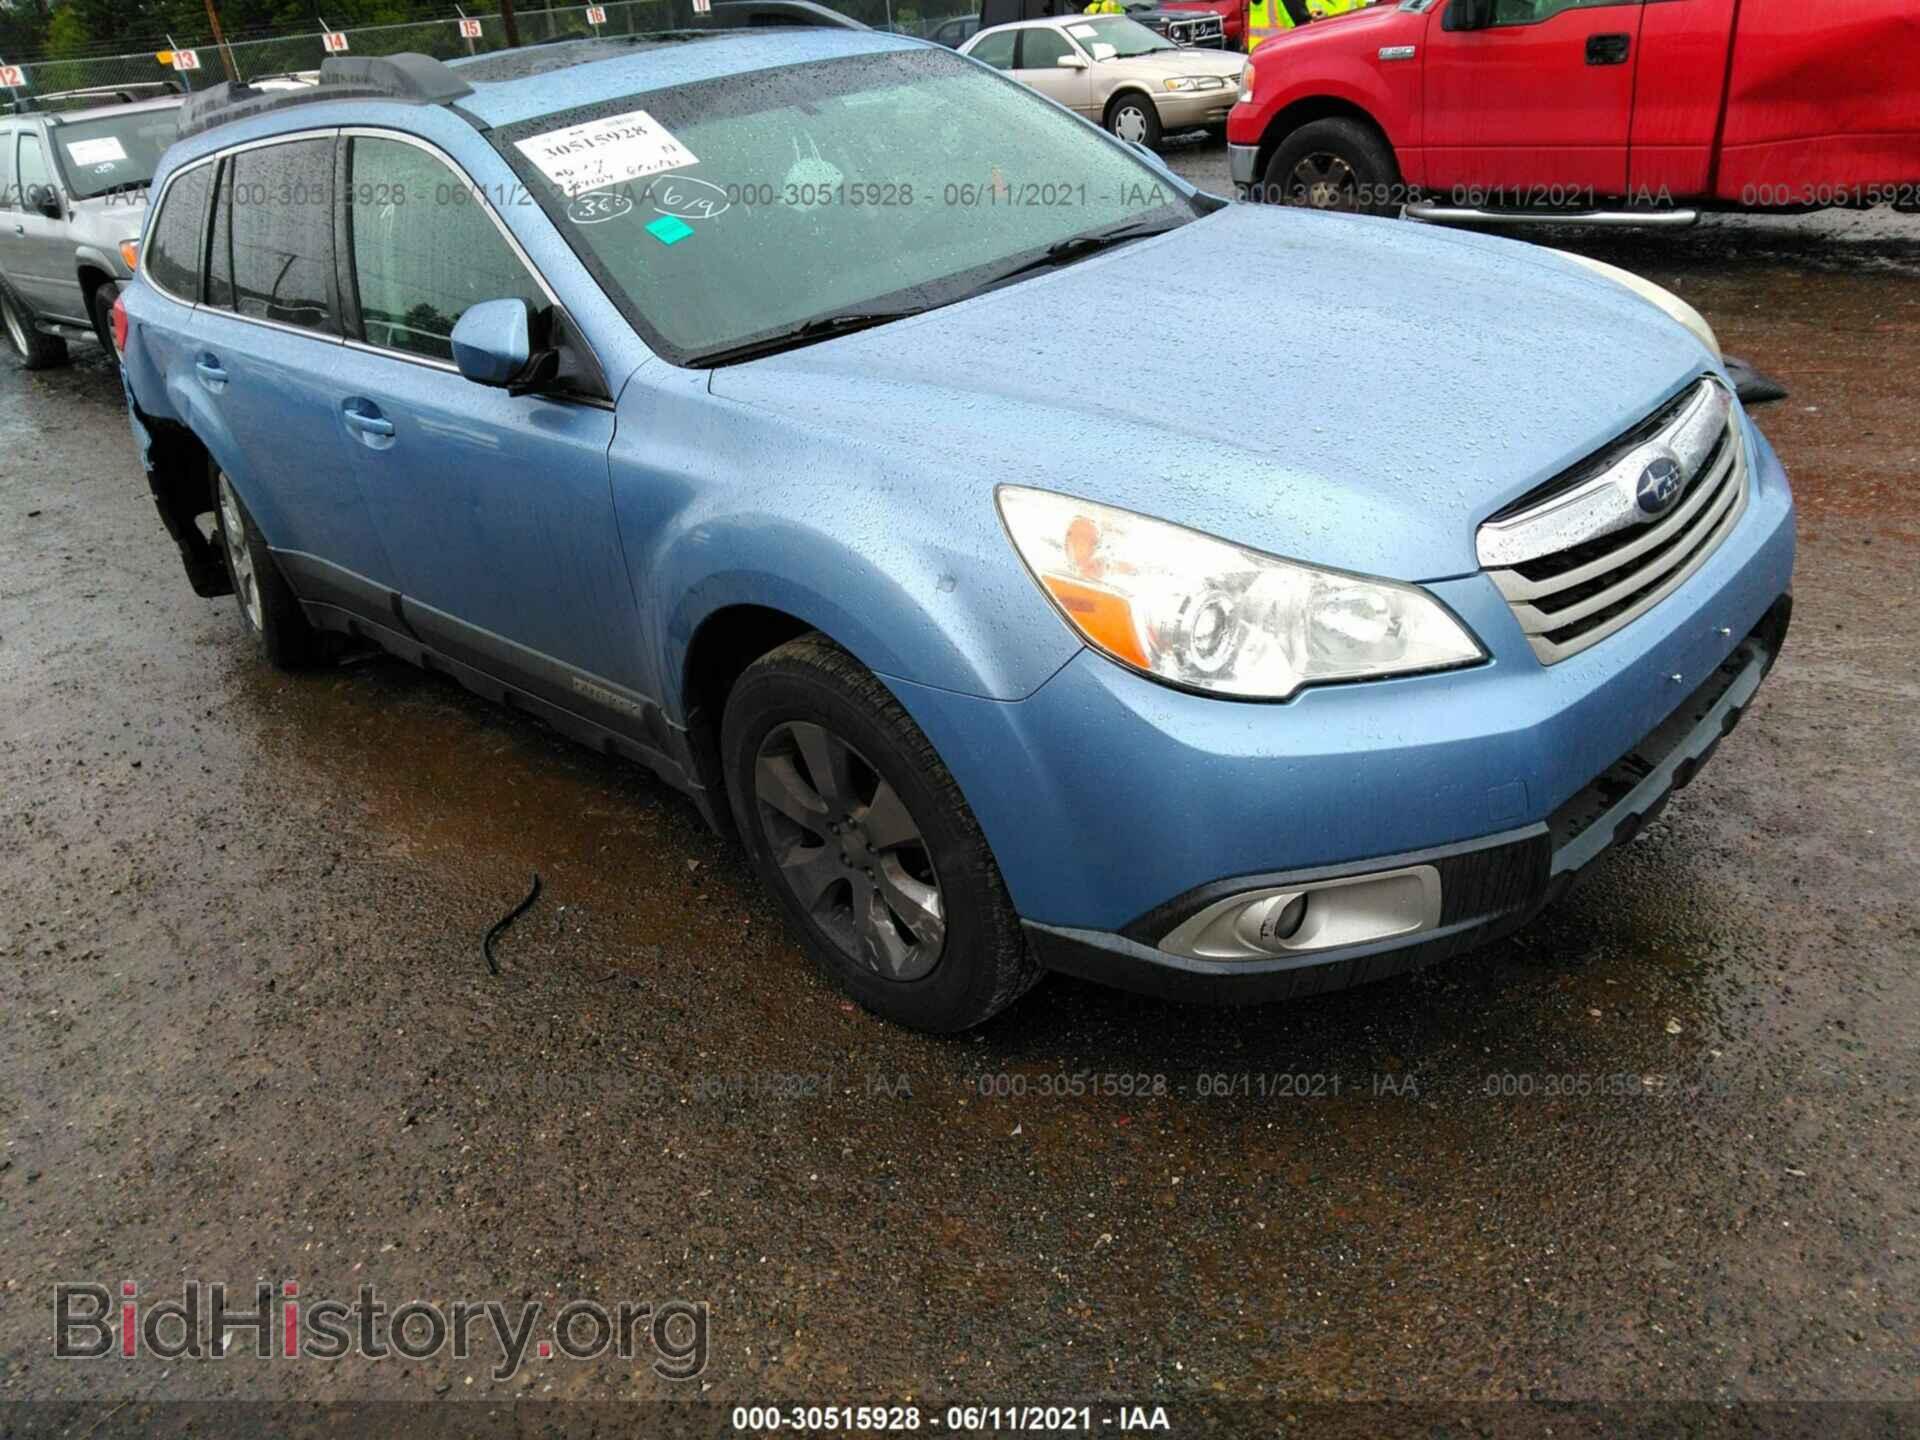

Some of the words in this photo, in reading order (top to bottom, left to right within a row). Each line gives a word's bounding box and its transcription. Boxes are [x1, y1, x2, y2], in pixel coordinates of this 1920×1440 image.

[462, 20, 479, 37] 15
[327, 32, 343, 49] 14
[174, 51, 195, 69] 13
[0, 67, 20, 86] 12
[543, 125, 649, 160] 30515928
